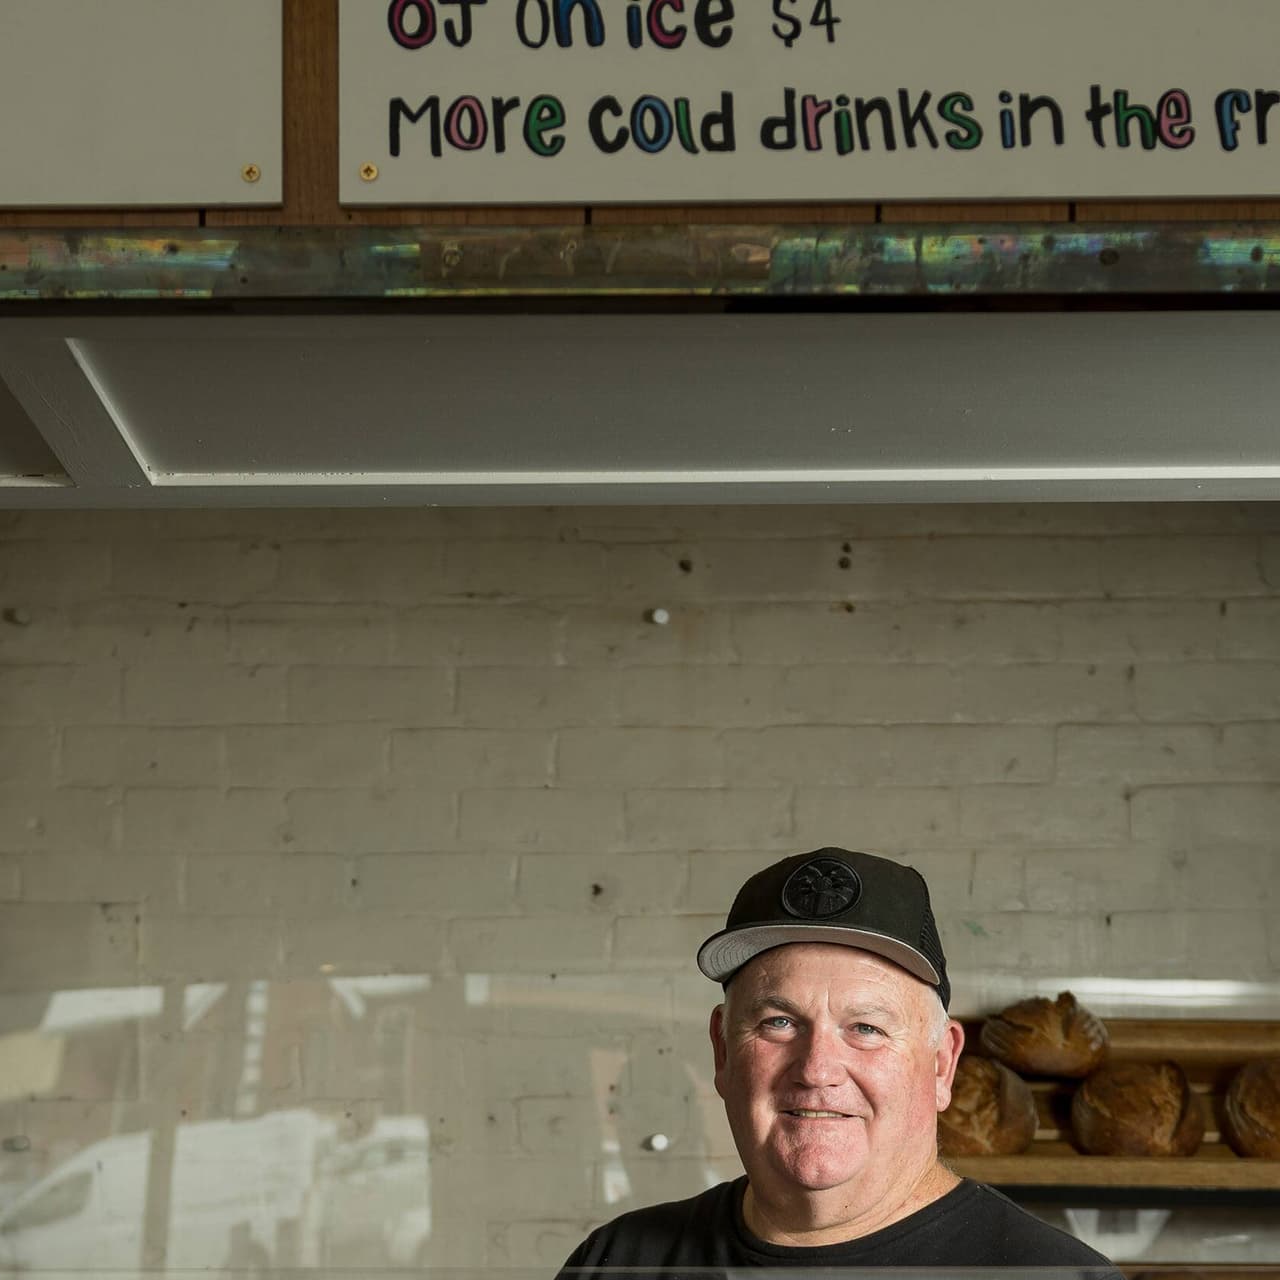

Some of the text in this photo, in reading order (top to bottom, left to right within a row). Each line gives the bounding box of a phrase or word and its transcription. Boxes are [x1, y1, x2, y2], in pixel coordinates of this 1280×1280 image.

[389, 94, 566, 157] More
[588, 91, 736, 154] cold
[760, 87, 982, 155] drinks
[998, 90, 1064, 149] in
[1086, 84, 1195, 150] the
